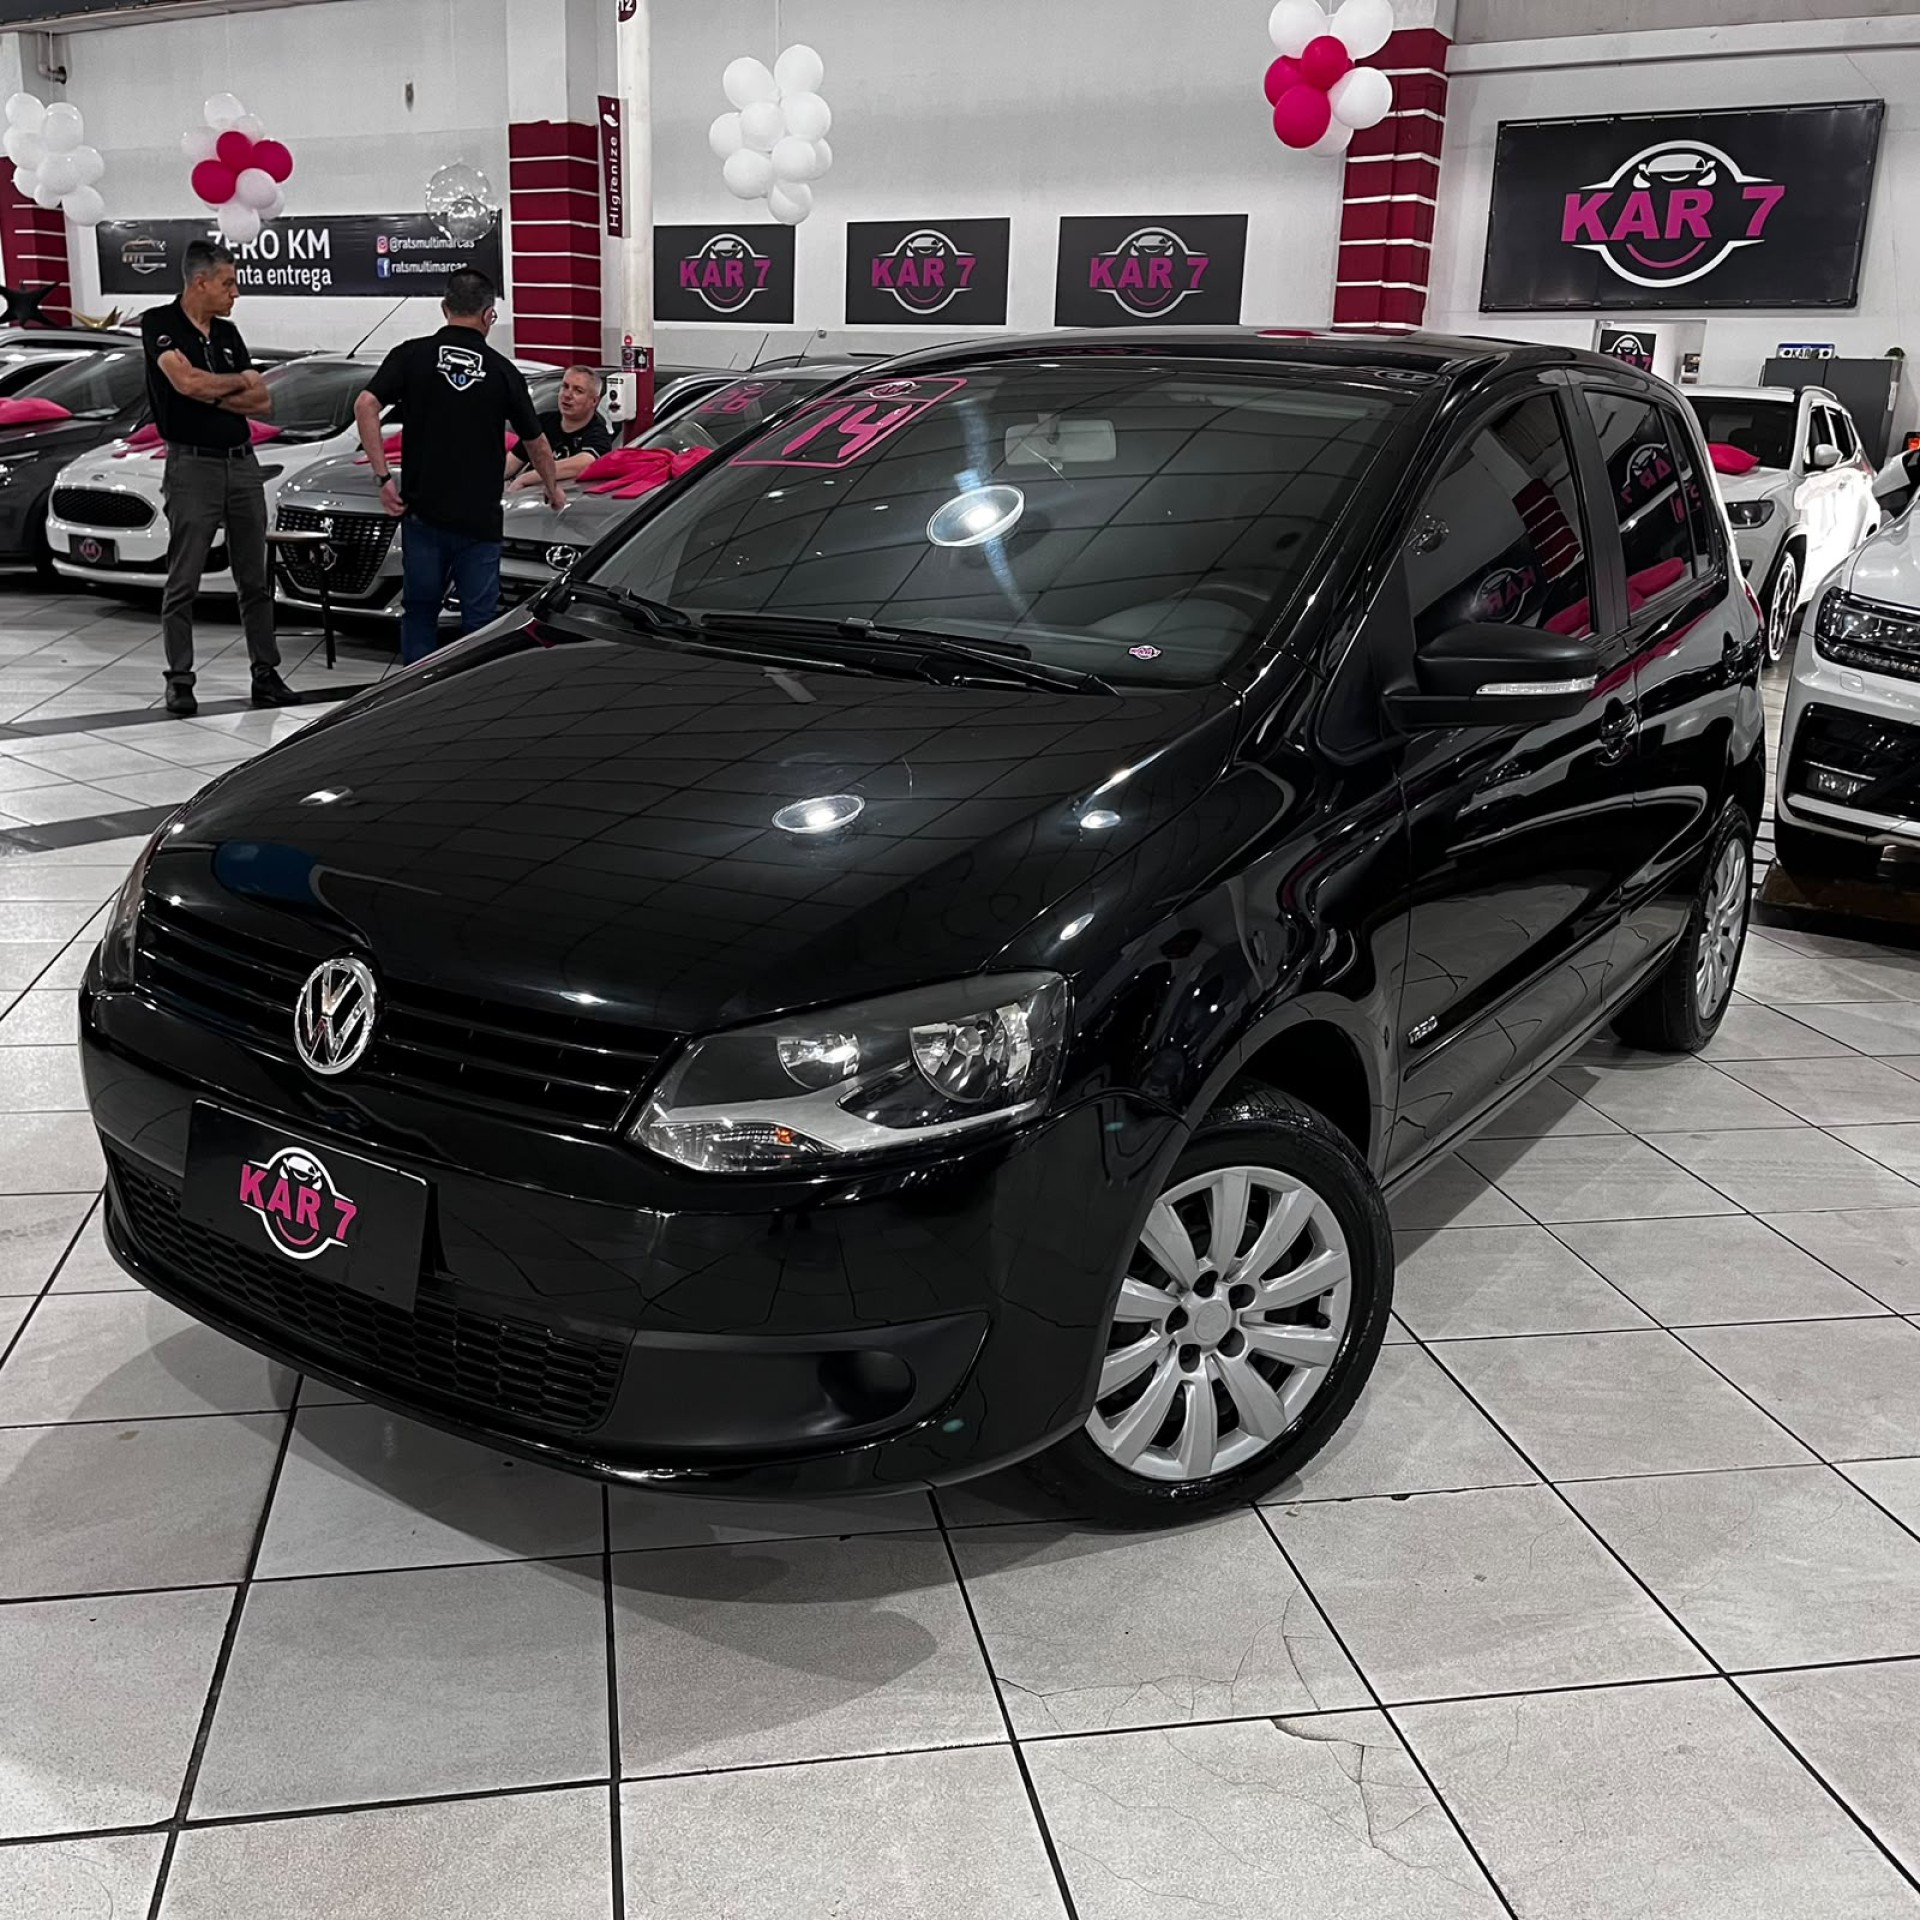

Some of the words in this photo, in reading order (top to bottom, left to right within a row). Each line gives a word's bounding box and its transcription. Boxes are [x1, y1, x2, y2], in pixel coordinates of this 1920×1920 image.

[609, 136, 621, 228] Higienize
[1561, 188, 1715, 242] KAR
[1742, 185, 1785, 237] 7
[287, 228, 331, 260] KM
[236, 264, 264, 285] nta
[267, 264, 333, 292] entrega
[680, 259, 744, 288] KAR
[753, 259, 772, 288] 7
[871, 257, 945, 287] KAR
[956, 257, 977, 287] 7
[1089, 257, 1174, 288] KAR
[1186, 257, 1209, 288] 7
[451, 372, 466, 385] 10
[780, 403, 913, 459] 14
[240, 1163, 321, 1231] KAR
[334, 1198, 358, 1240] 7
